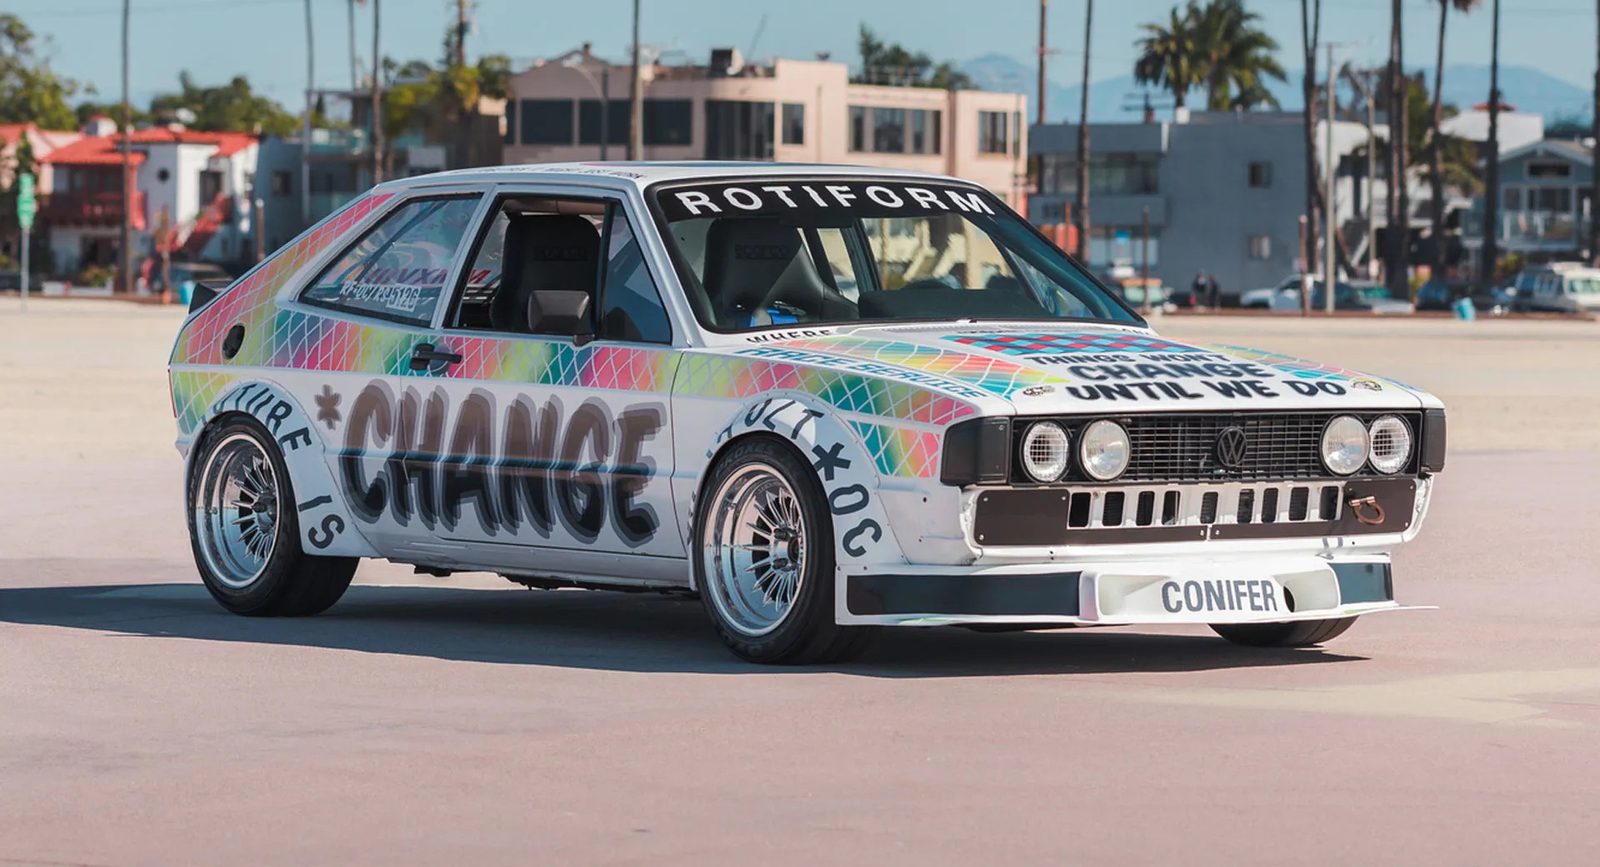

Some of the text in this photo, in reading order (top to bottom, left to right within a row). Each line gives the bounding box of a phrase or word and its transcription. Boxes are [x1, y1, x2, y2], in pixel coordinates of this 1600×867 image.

[674, 185, 996, 215] ROTIFORM
[735, 346, 851, 367] RACE
[850, 362, 988, 398] SERVICE
[1023, 354, 1137, 365] THINGS
[1066, 363, 1275, 381] CHANGE
[1065, 381, 1204, 400] UNTIL
[1200, 380, 1280, 398] WE
[1281, 381, 1347, 397] DO
[202, 383, 346, 550] UTURE IS
[1162, 579, 1278, 614] CONIFER
